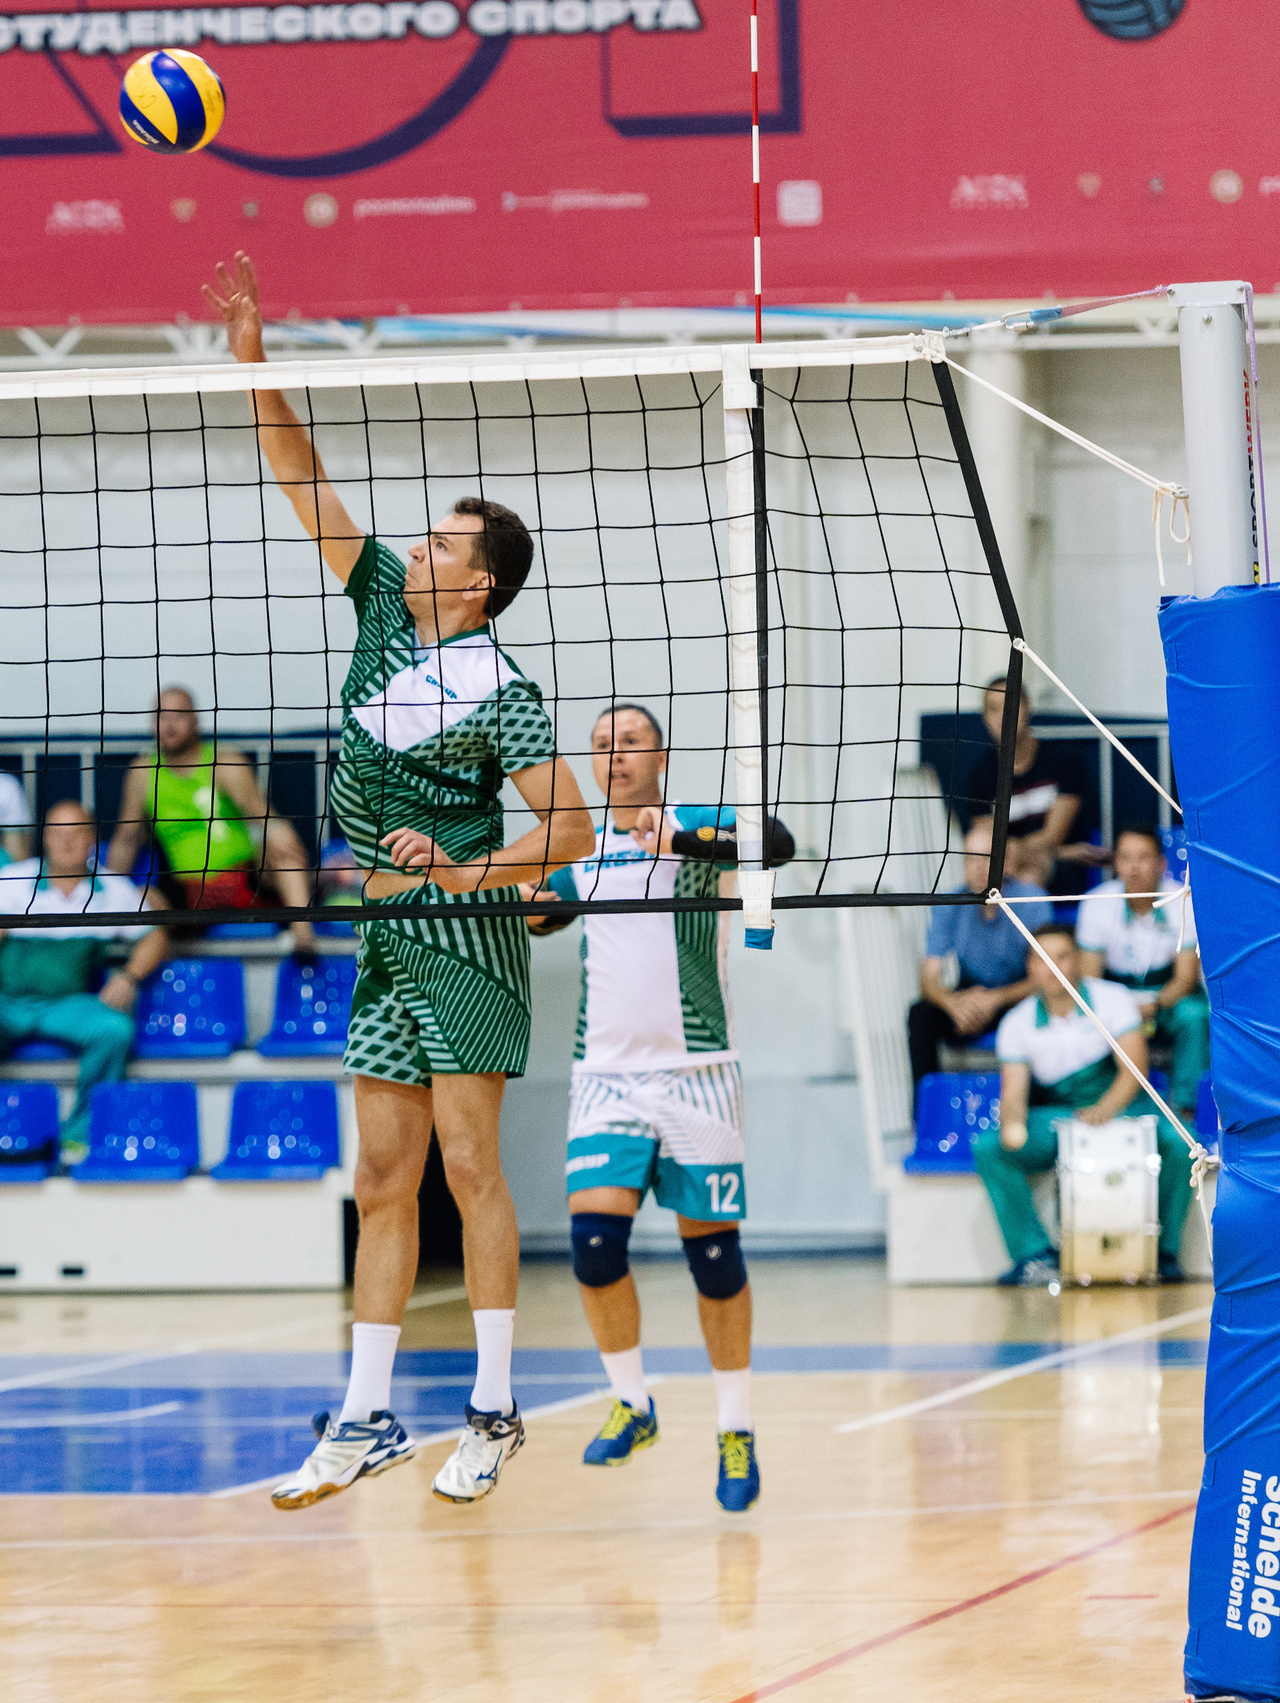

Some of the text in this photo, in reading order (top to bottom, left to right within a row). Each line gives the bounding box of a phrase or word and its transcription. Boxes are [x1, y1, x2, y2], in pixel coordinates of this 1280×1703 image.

[469, 0, 701, 36] СПОРТА
[705, 1171, 741, 1214] 12
[1225, 1469, 1262, 1631] International
